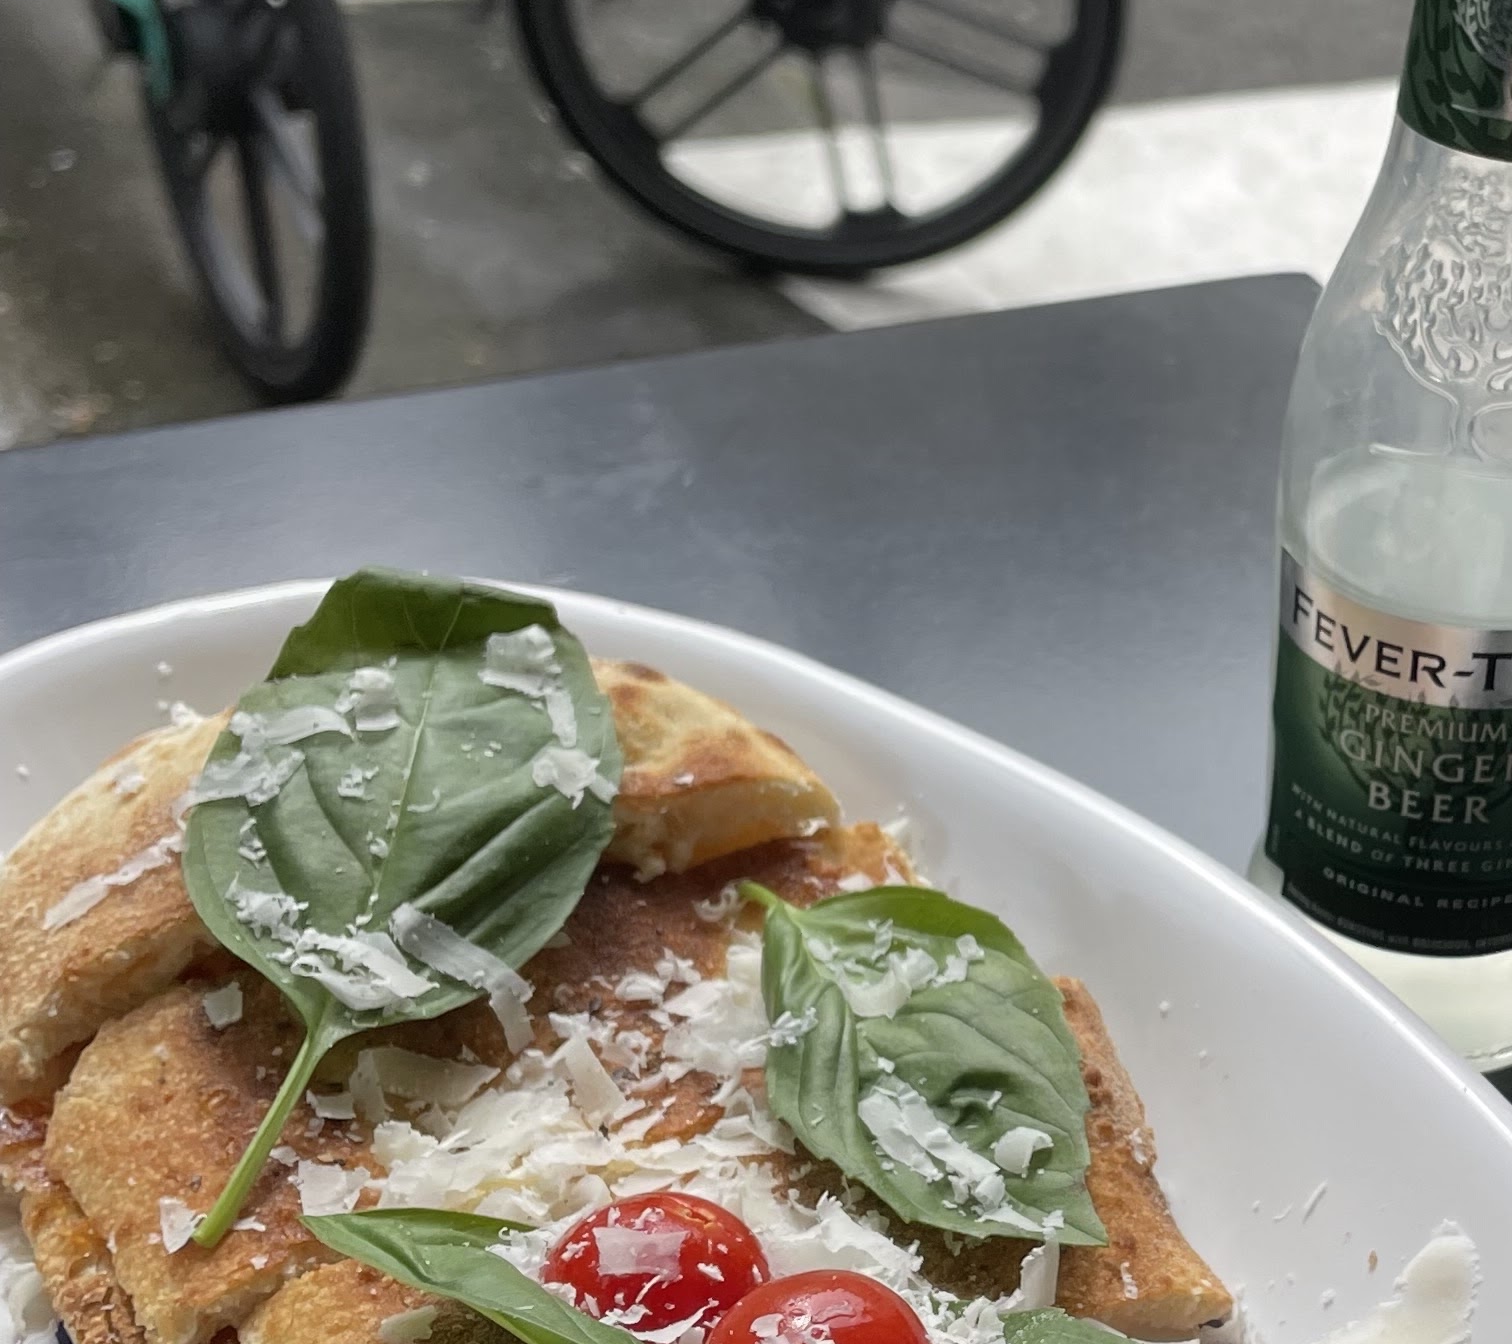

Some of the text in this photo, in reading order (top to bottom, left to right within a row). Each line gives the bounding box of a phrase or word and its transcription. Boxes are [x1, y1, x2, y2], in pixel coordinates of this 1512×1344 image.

[1365, 703, 1509, 744] PREMIUM
[1367, 779, 1491, 825] BEER
[1306, 815, 1364, 854] BLEND
[1402, 855, 1471, 874] THREE
[1326, 807, 1401, 845] NATURAL
[1322, 865, 1425, 908] ORIGINAL
